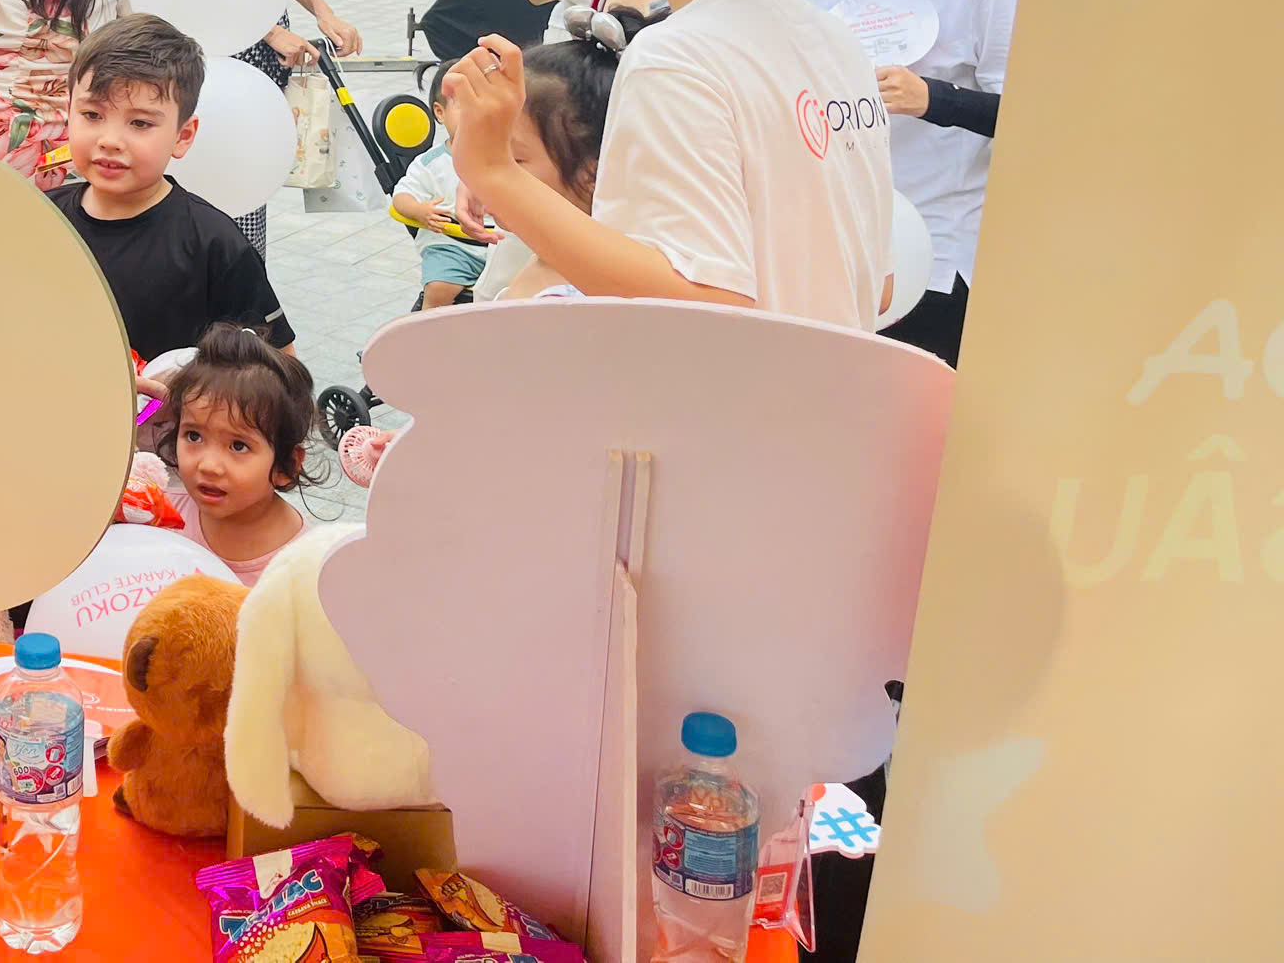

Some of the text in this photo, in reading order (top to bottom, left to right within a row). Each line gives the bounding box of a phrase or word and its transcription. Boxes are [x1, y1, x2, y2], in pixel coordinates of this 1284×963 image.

[826, 97, 887, 132] ORION
[70, 569, 177, 606] KARATE CLUB
